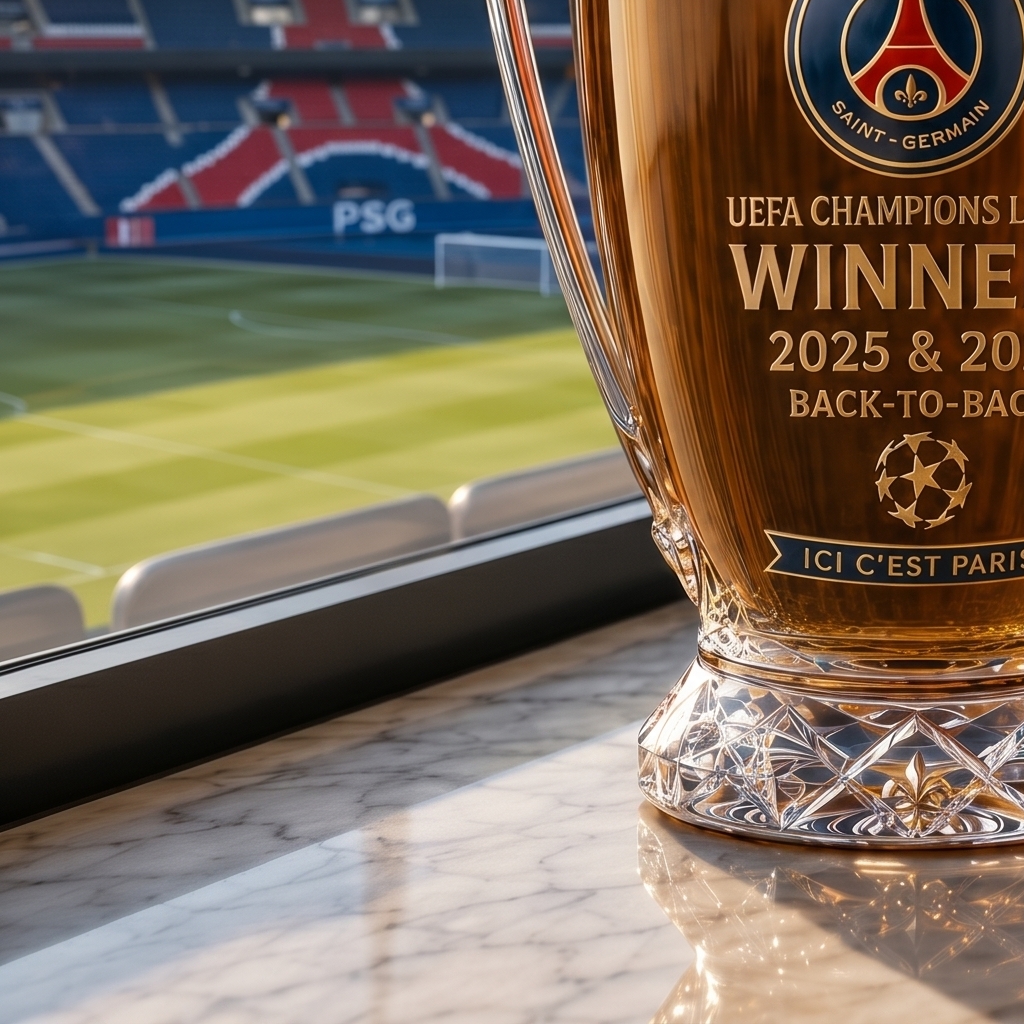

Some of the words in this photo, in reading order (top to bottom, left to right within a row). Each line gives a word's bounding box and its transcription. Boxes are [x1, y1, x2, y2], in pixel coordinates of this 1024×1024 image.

[332, 198, 418, 234] PSG
[726, 195, 804, 227] UEFA
[810, 194, 1001, 226] CHAMPIONS
[768, 329, 890, 373] 2025
[907, 329, 943, 373] &
[803, 547, 843, 574] ICI
[855, 553, 942, 577] C'EST
